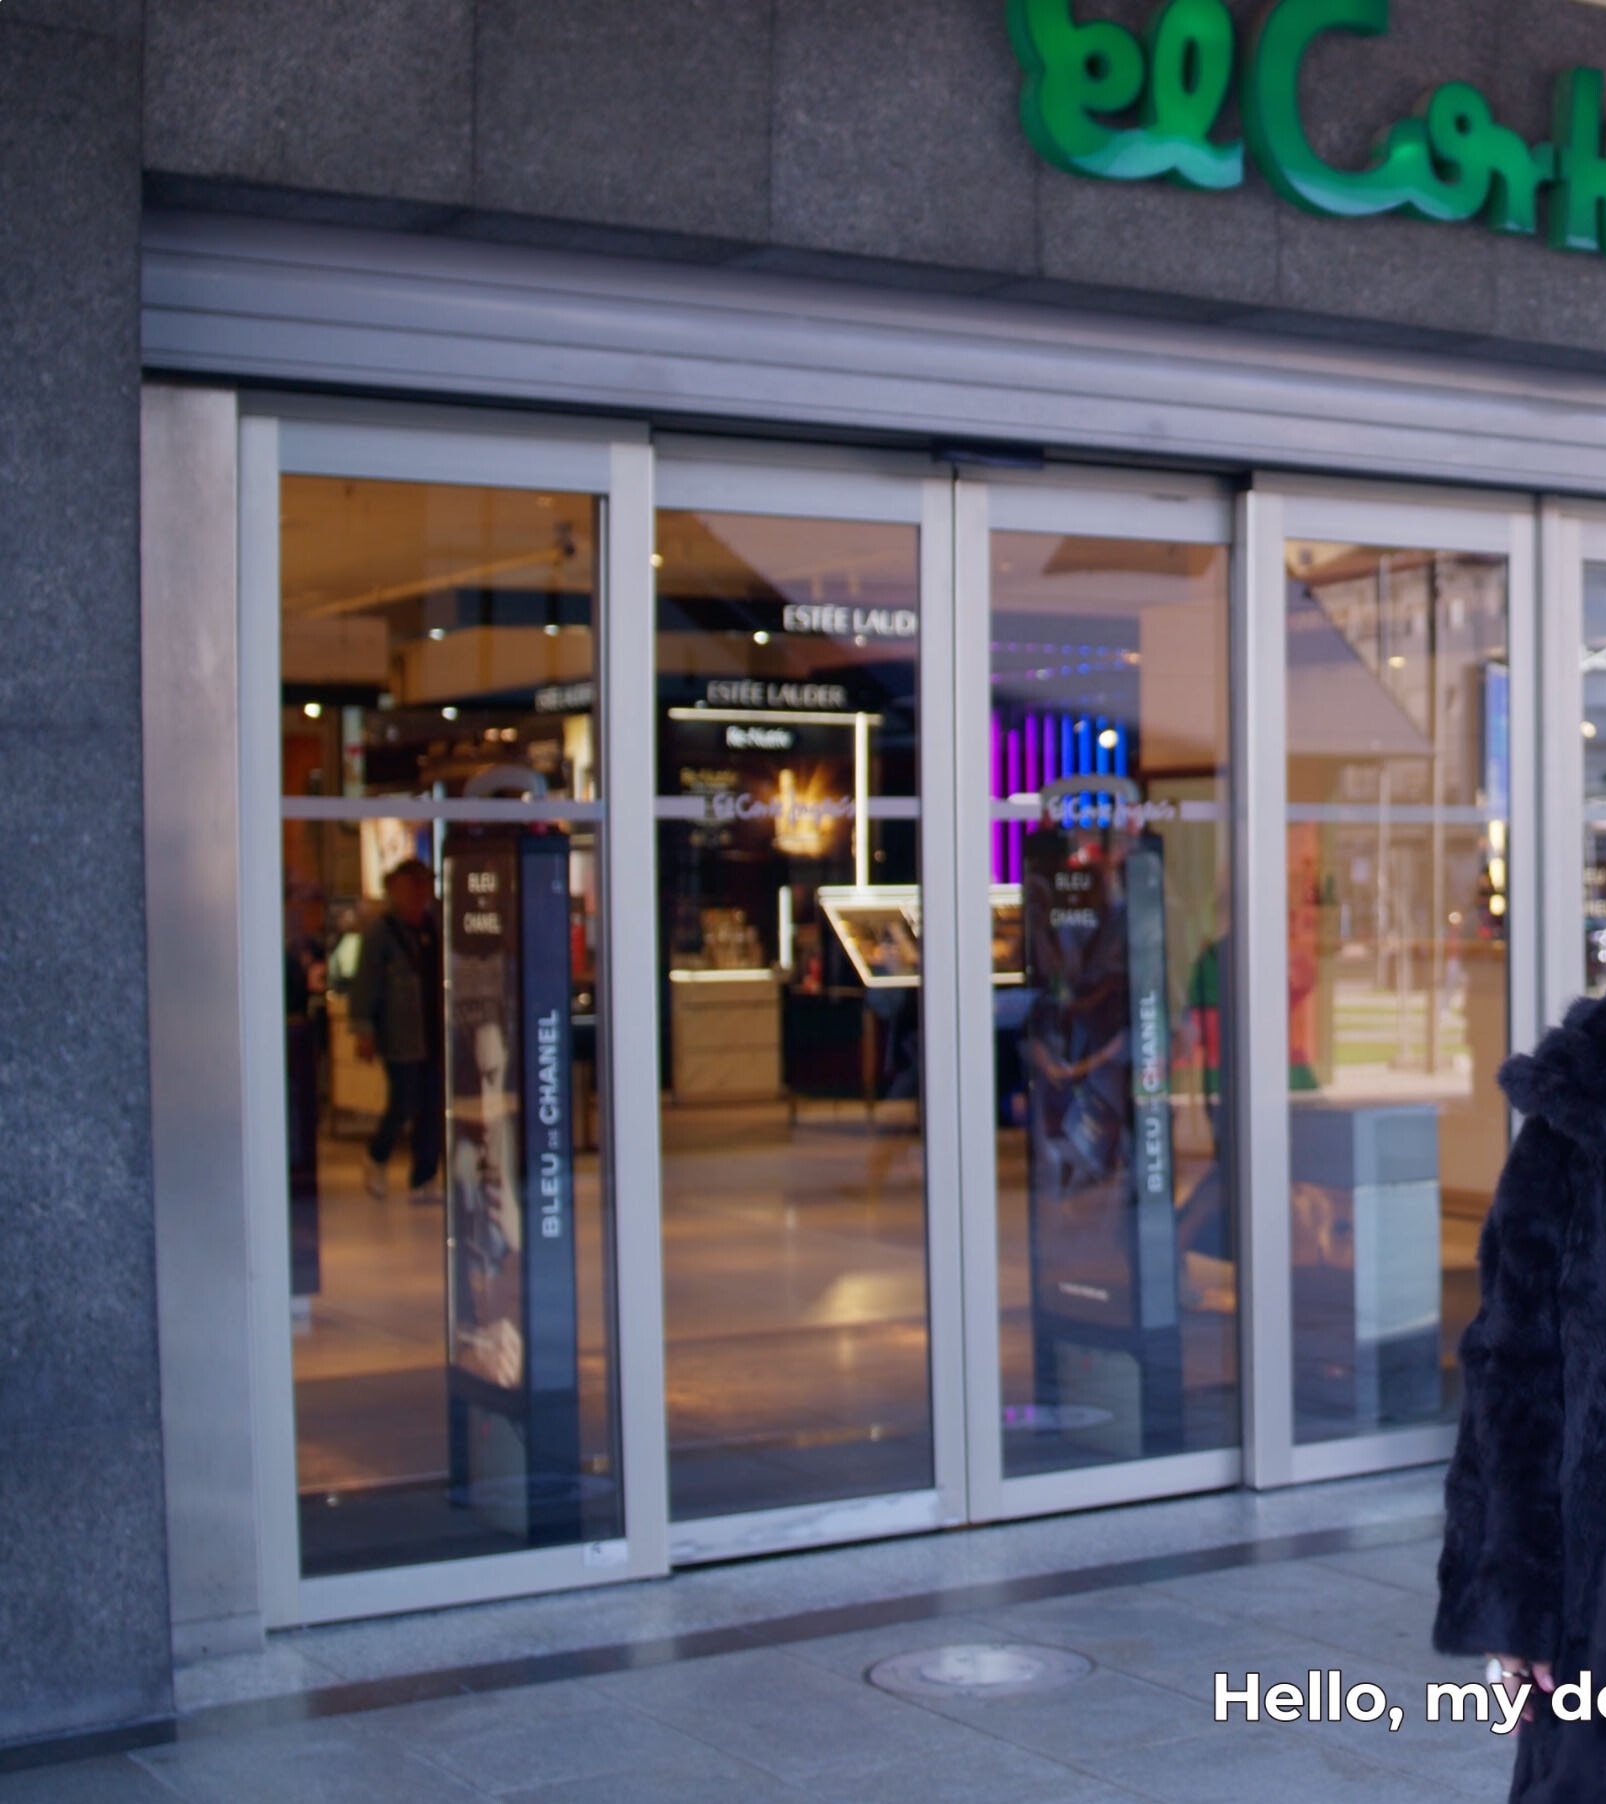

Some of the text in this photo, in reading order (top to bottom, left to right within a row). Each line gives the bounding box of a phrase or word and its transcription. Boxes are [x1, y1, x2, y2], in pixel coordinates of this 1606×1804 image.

[853, 607, 917, 636] LAUD
[467, 871, 497, 893] BLEU
[1055, 871, 1091, 891] BLEU
[463, 912, 501, 934] CHANEL
[538, 1009, 560, 1126] CHANEL
[1139, 990, 1161, 1093] CHANEL
[1145, 1116, 1164, 1194] BLEU
[540, 1153, 562, 1239] BLEU
